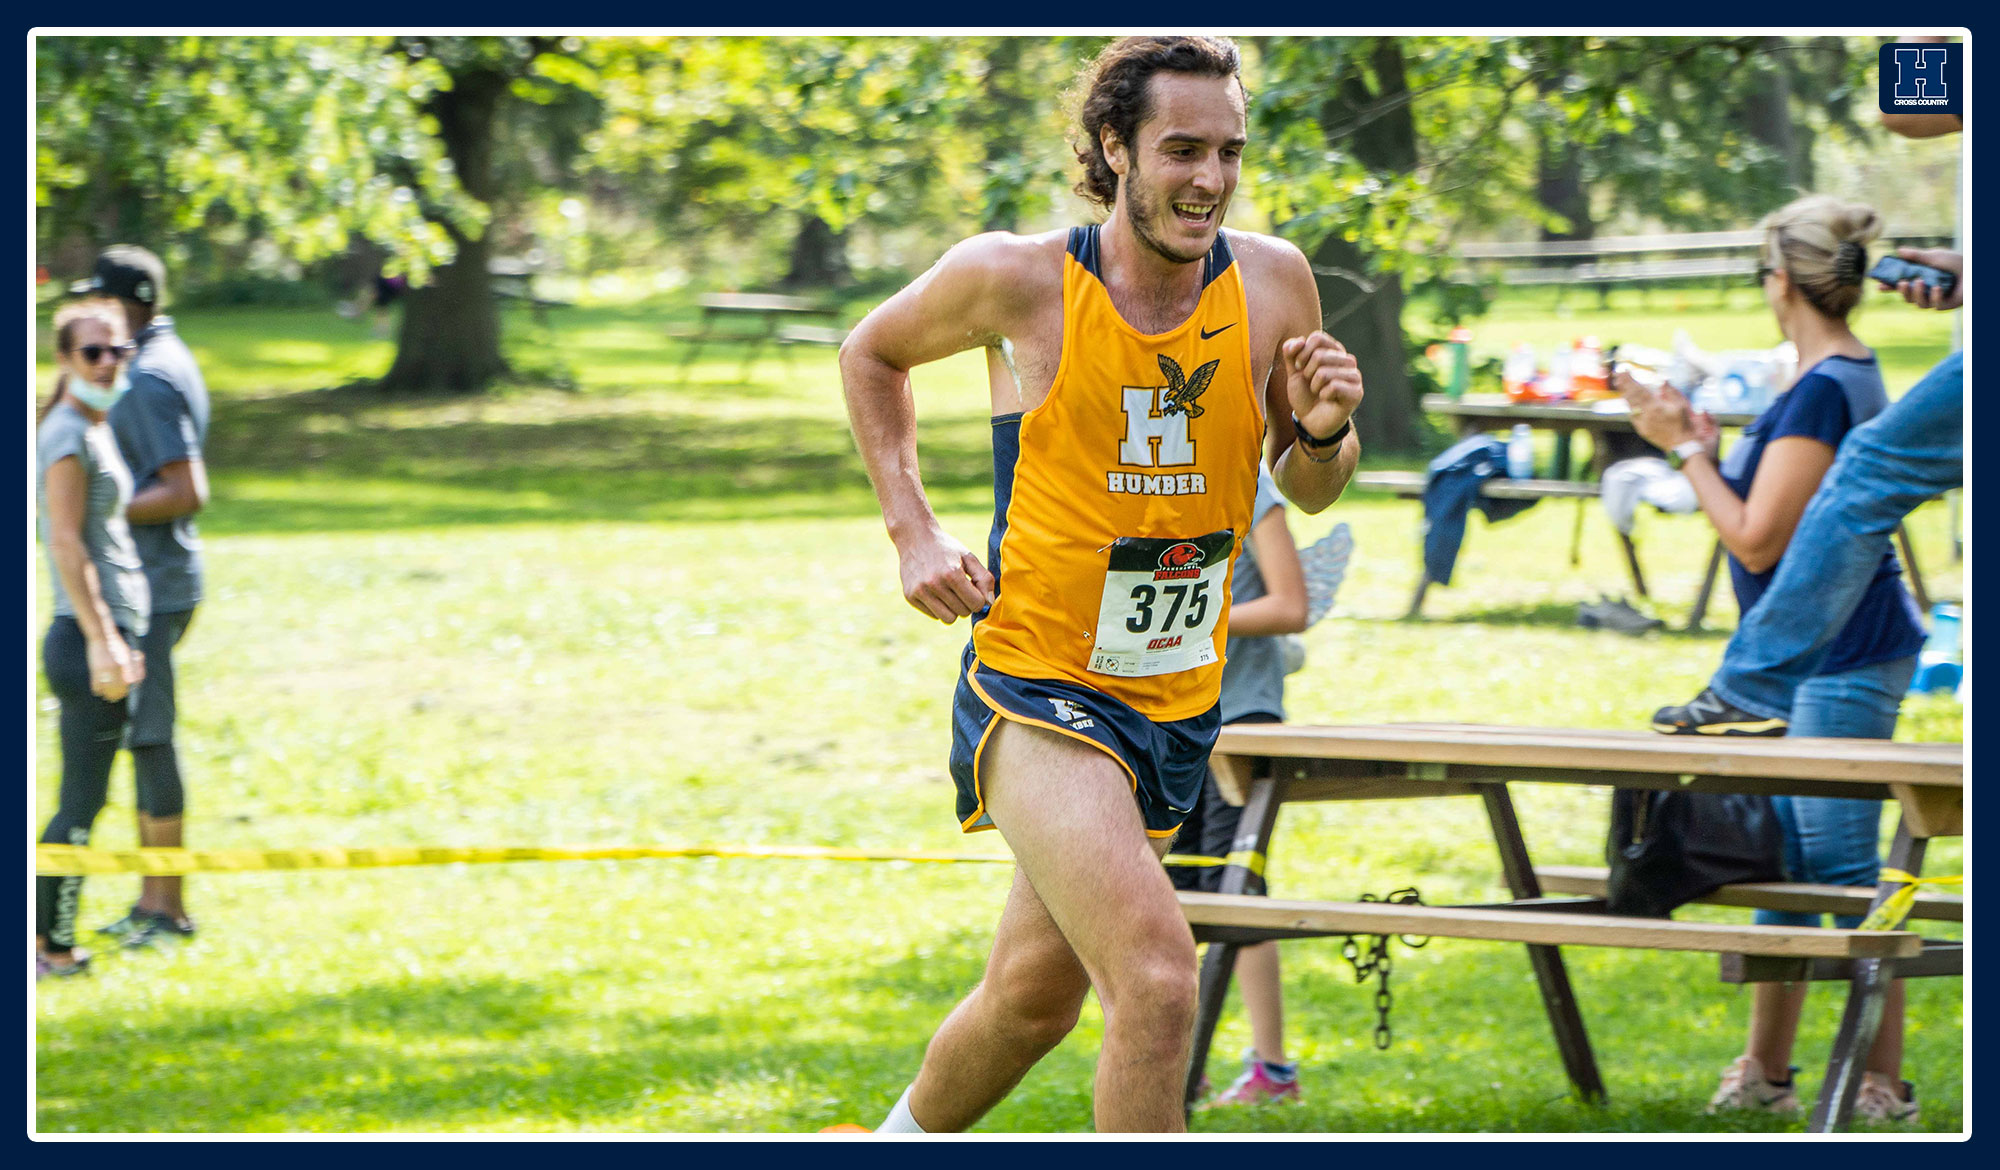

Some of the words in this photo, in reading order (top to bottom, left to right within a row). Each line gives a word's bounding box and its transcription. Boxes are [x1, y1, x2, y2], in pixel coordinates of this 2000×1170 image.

[1118, 385, 1197, 467] H
[1106, 471, 1207, 496] HUMBER
[1153, 568, 1201, 581] FALCONS
[1125, 579, 1210, 634] 375
